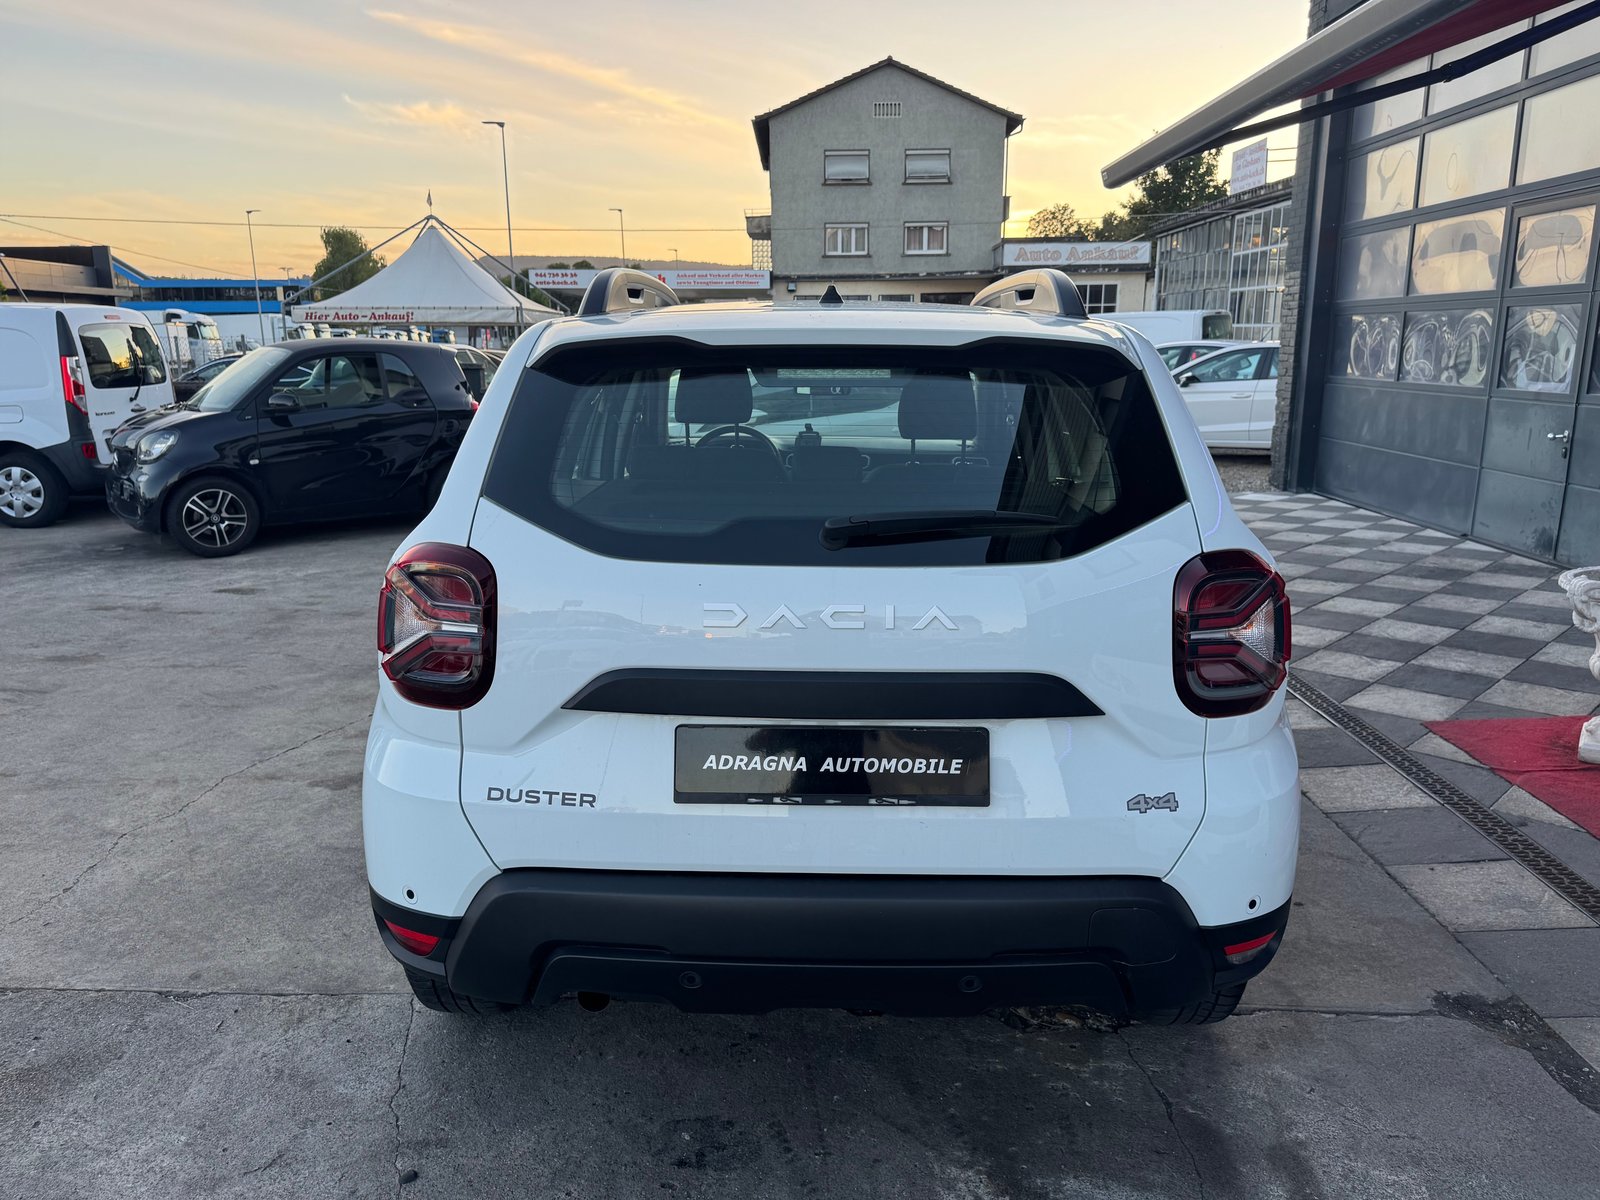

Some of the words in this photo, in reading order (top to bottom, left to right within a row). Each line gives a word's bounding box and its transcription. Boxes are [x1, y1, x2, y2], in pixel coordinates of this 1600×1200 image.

[1014, 247, 1062, 262] Auto
[1066, 246, 1140, 261] Ankauf
[305, 311, 330, 321] Hier
[702, 601, 958, 631] DACIA
[702, 754, 808, 772] ADRAGNA
[819, 756, 964, 775] AUTOMOBILE
[486, 786, 597, 808] DUSTER
[1127, 791, 1179, 814] 4x4
